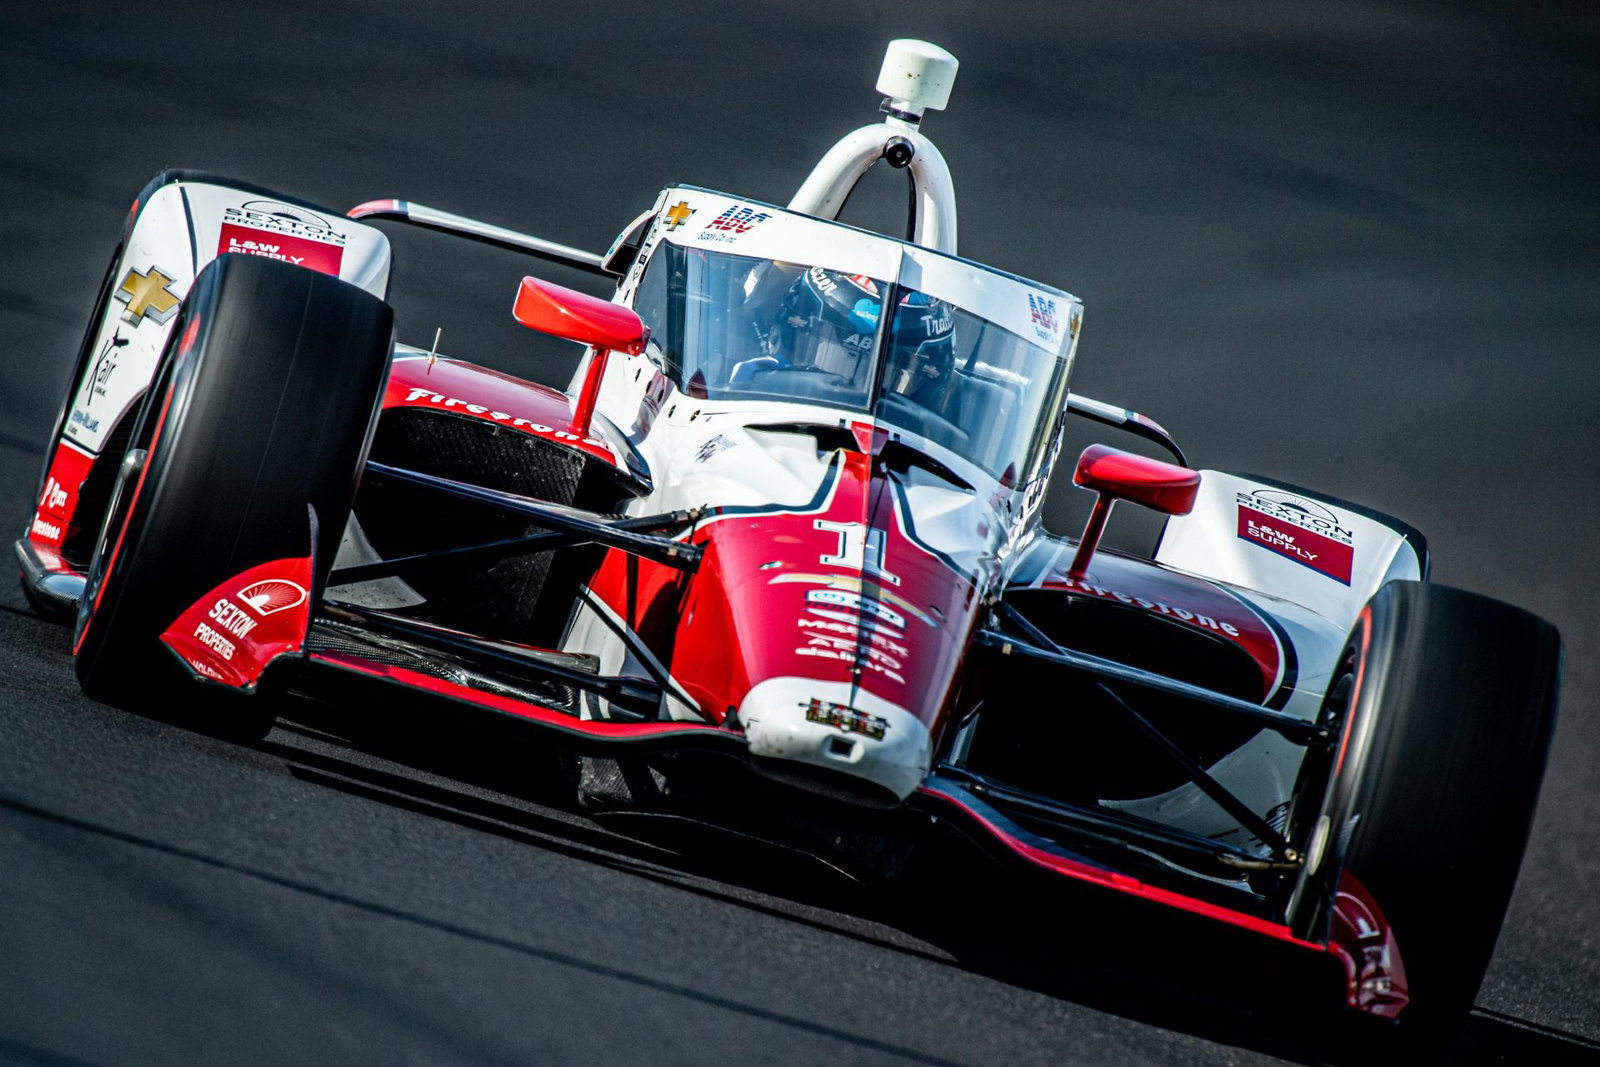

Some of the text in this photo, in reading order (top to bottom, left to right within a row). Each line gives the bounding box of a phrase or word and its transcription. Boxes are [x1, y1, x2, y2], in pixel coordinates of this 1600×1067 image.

[224, 216, 346, 245] PROPERTIES
[225, 208, 346, 239] SEXTON
[229, 238, 280, 253] L&W
[845, 333, 873, 350] AB
[405, 388, 609, 449] Firestone
[1236, 493, 1352, 538] SEXTON
[1236, 499, 1352, 544] PROPERTIES
[1248, 520, 1295, 543] L&W
[1247, 527, 1318, 560] SUPPLY
[208, 598, 258, 640] SEXTON
[1052, 575, 1240, 637] Firestone
[193, 621, 236, 661] PROPERTIES
